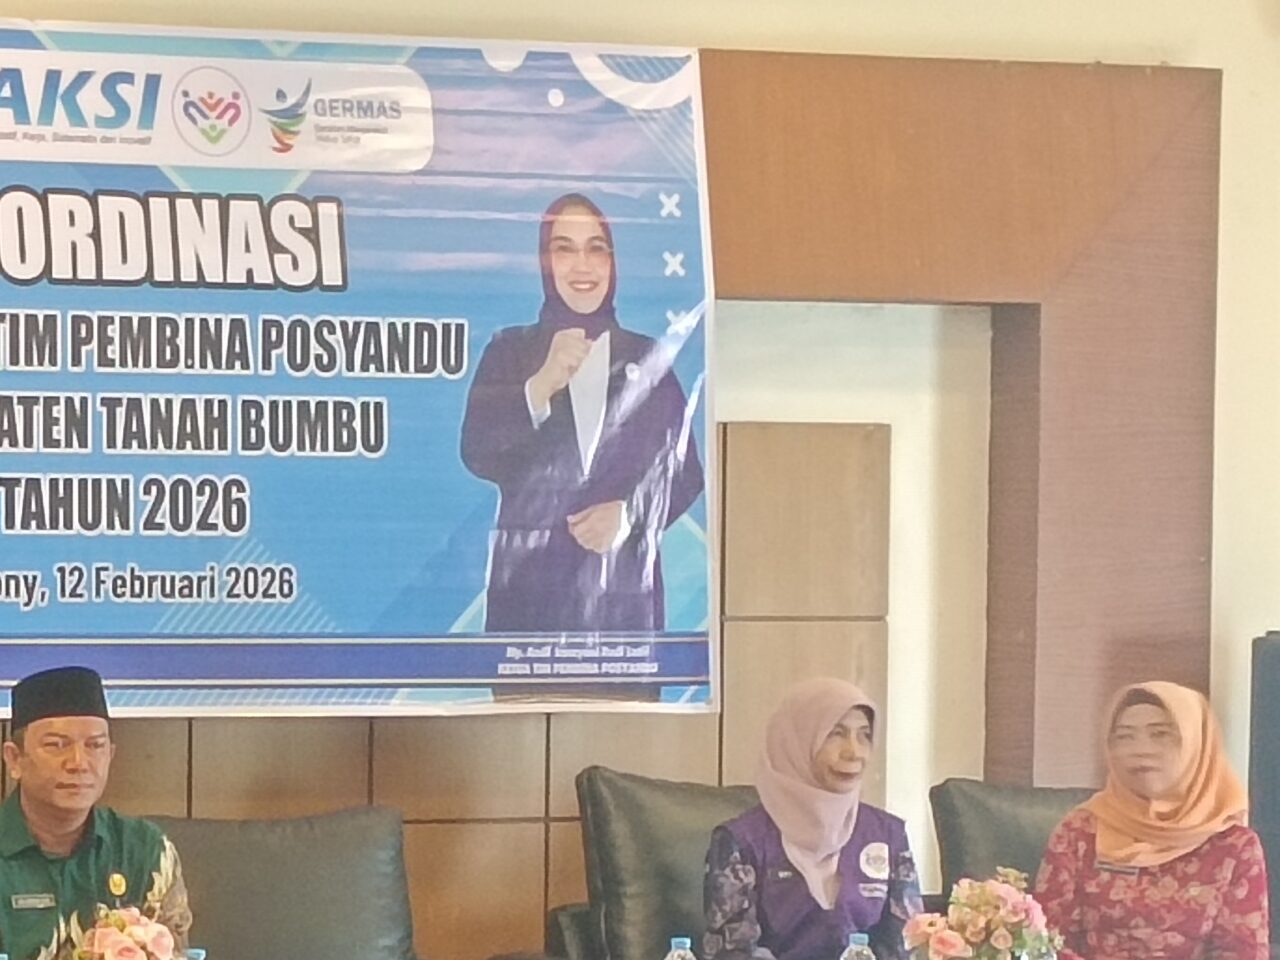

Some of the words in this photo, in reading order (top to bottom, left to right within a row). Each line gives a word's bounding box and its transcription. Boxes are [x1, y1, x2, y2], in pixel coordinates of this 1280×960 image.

[313, 97, 403, 120] GERMAS
[69, 315, 252, 373] PEMBINA
[261, 319, 467, 377] POSYANDU
[100, 396, 229, 452] TANAH
[239, 399, 386, 455] BUMBU
[143, 477, 248, 534] 2026
[56, 566, 86, 599] 12
[94, 565, 218, 601] Februari
[226, 567, 295, 601] 2026
